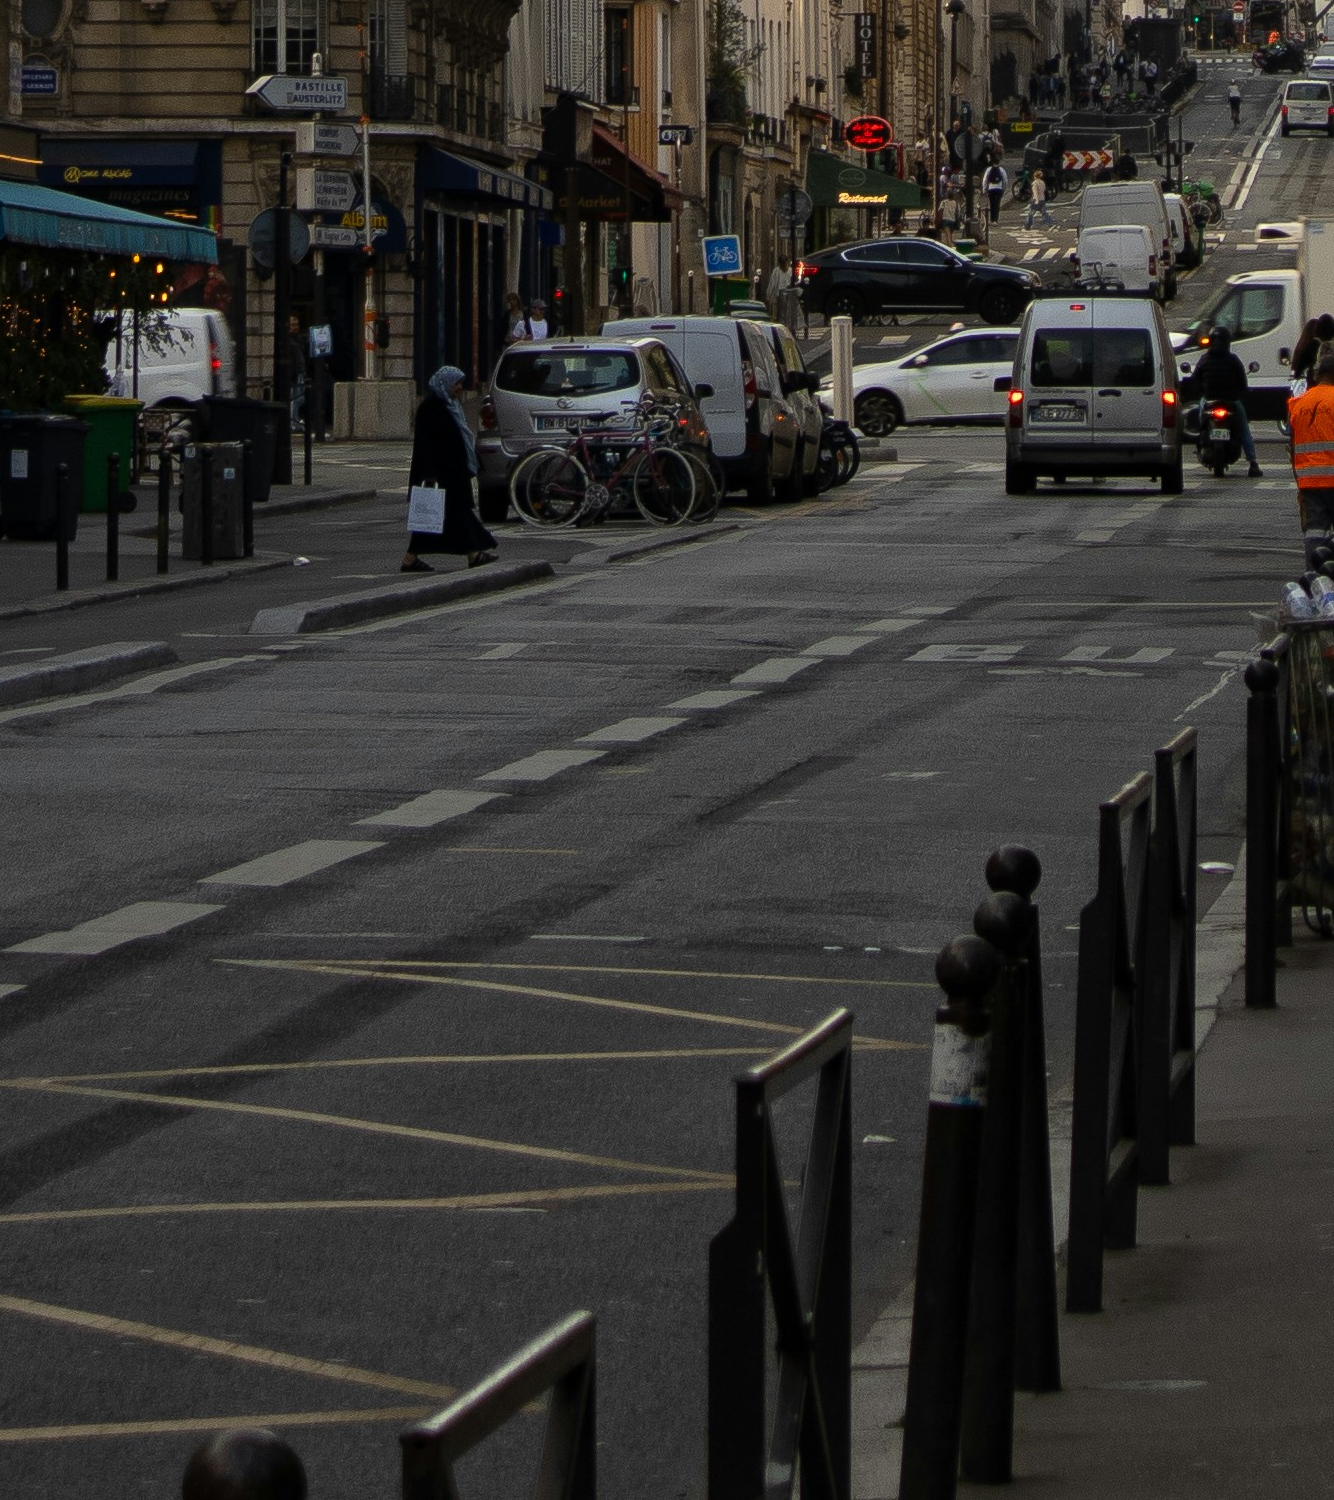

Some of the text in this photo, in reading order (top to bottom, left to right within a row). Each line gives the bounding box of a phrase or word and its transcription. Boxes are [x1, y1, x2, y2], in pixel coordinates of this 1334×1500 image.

[860, 14, 872, 77] HOTEL
[295, 82, 343, 92] BASTILLE
[293, 94, 343, 104] AUSTERLITZ
[108, 187, 190, 204] magazines
